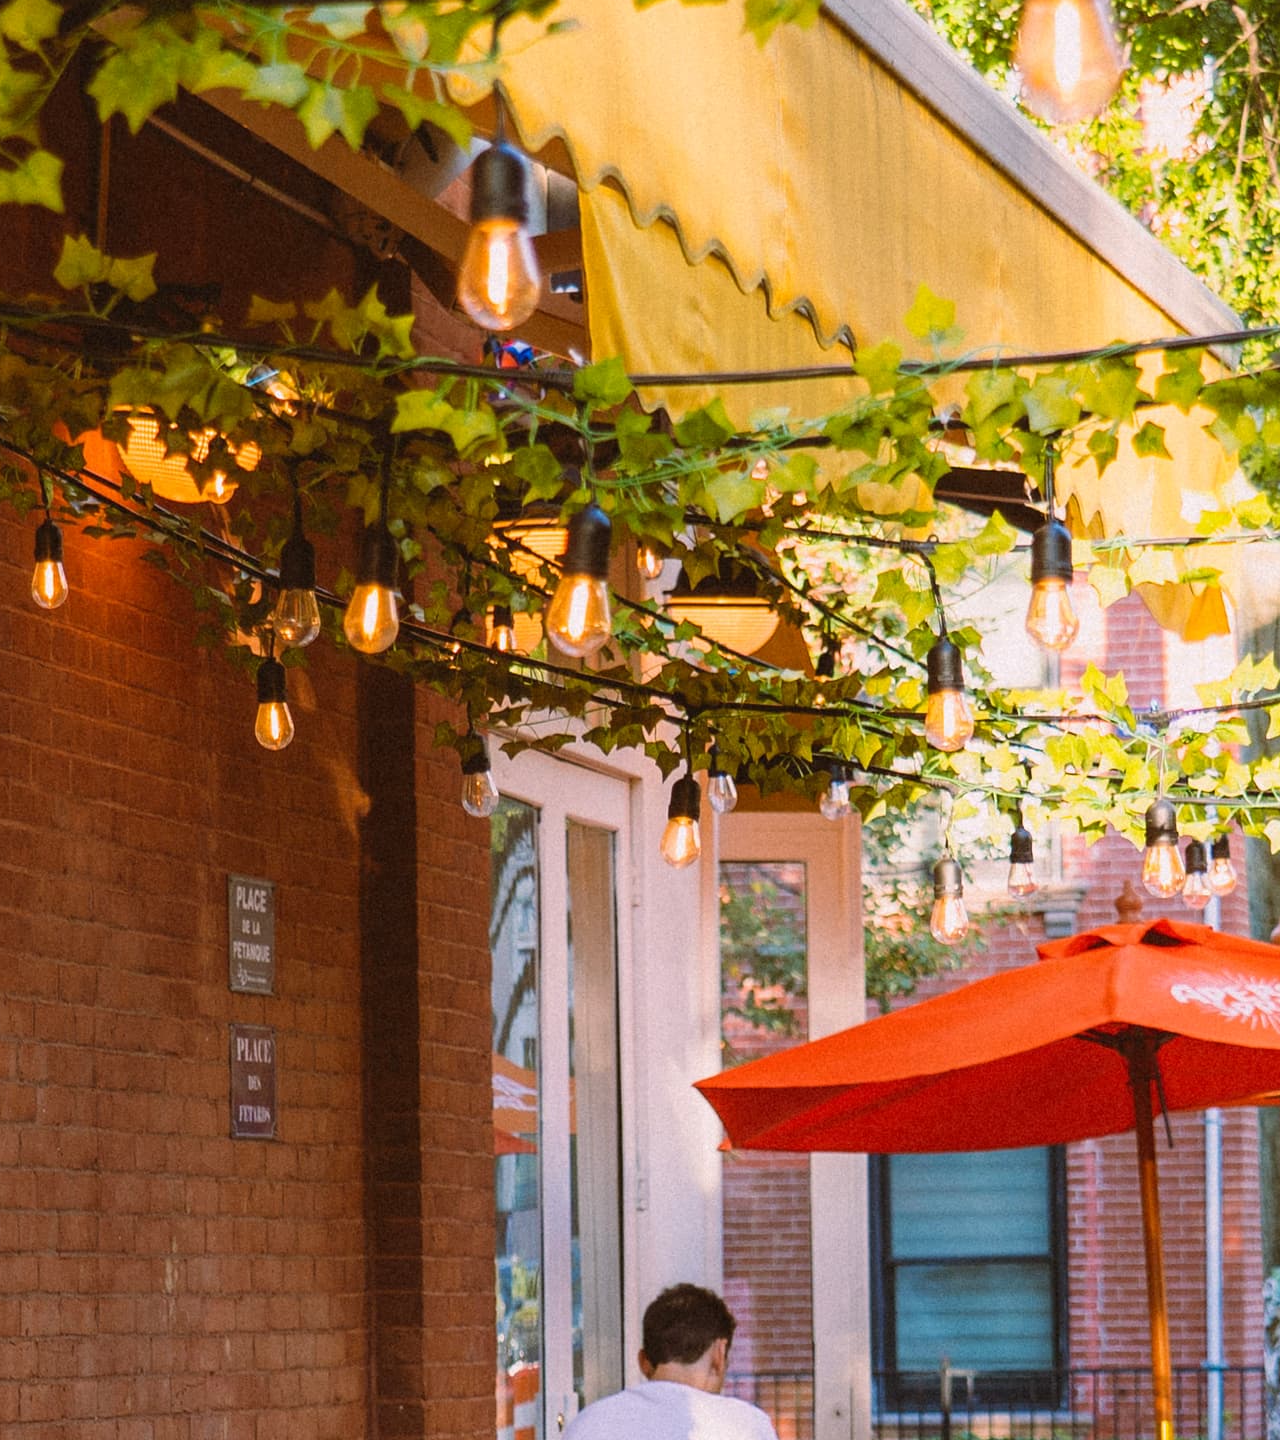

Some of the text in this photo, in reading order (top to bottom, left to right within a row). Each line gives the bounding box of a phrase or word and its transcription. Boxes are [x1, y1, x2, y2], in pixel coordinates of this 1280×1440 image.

[236, 885, 267, 913] PLACE
[242, 919, 261, 936] DE LA
[237, 1037, 272, 1064] PLACE
